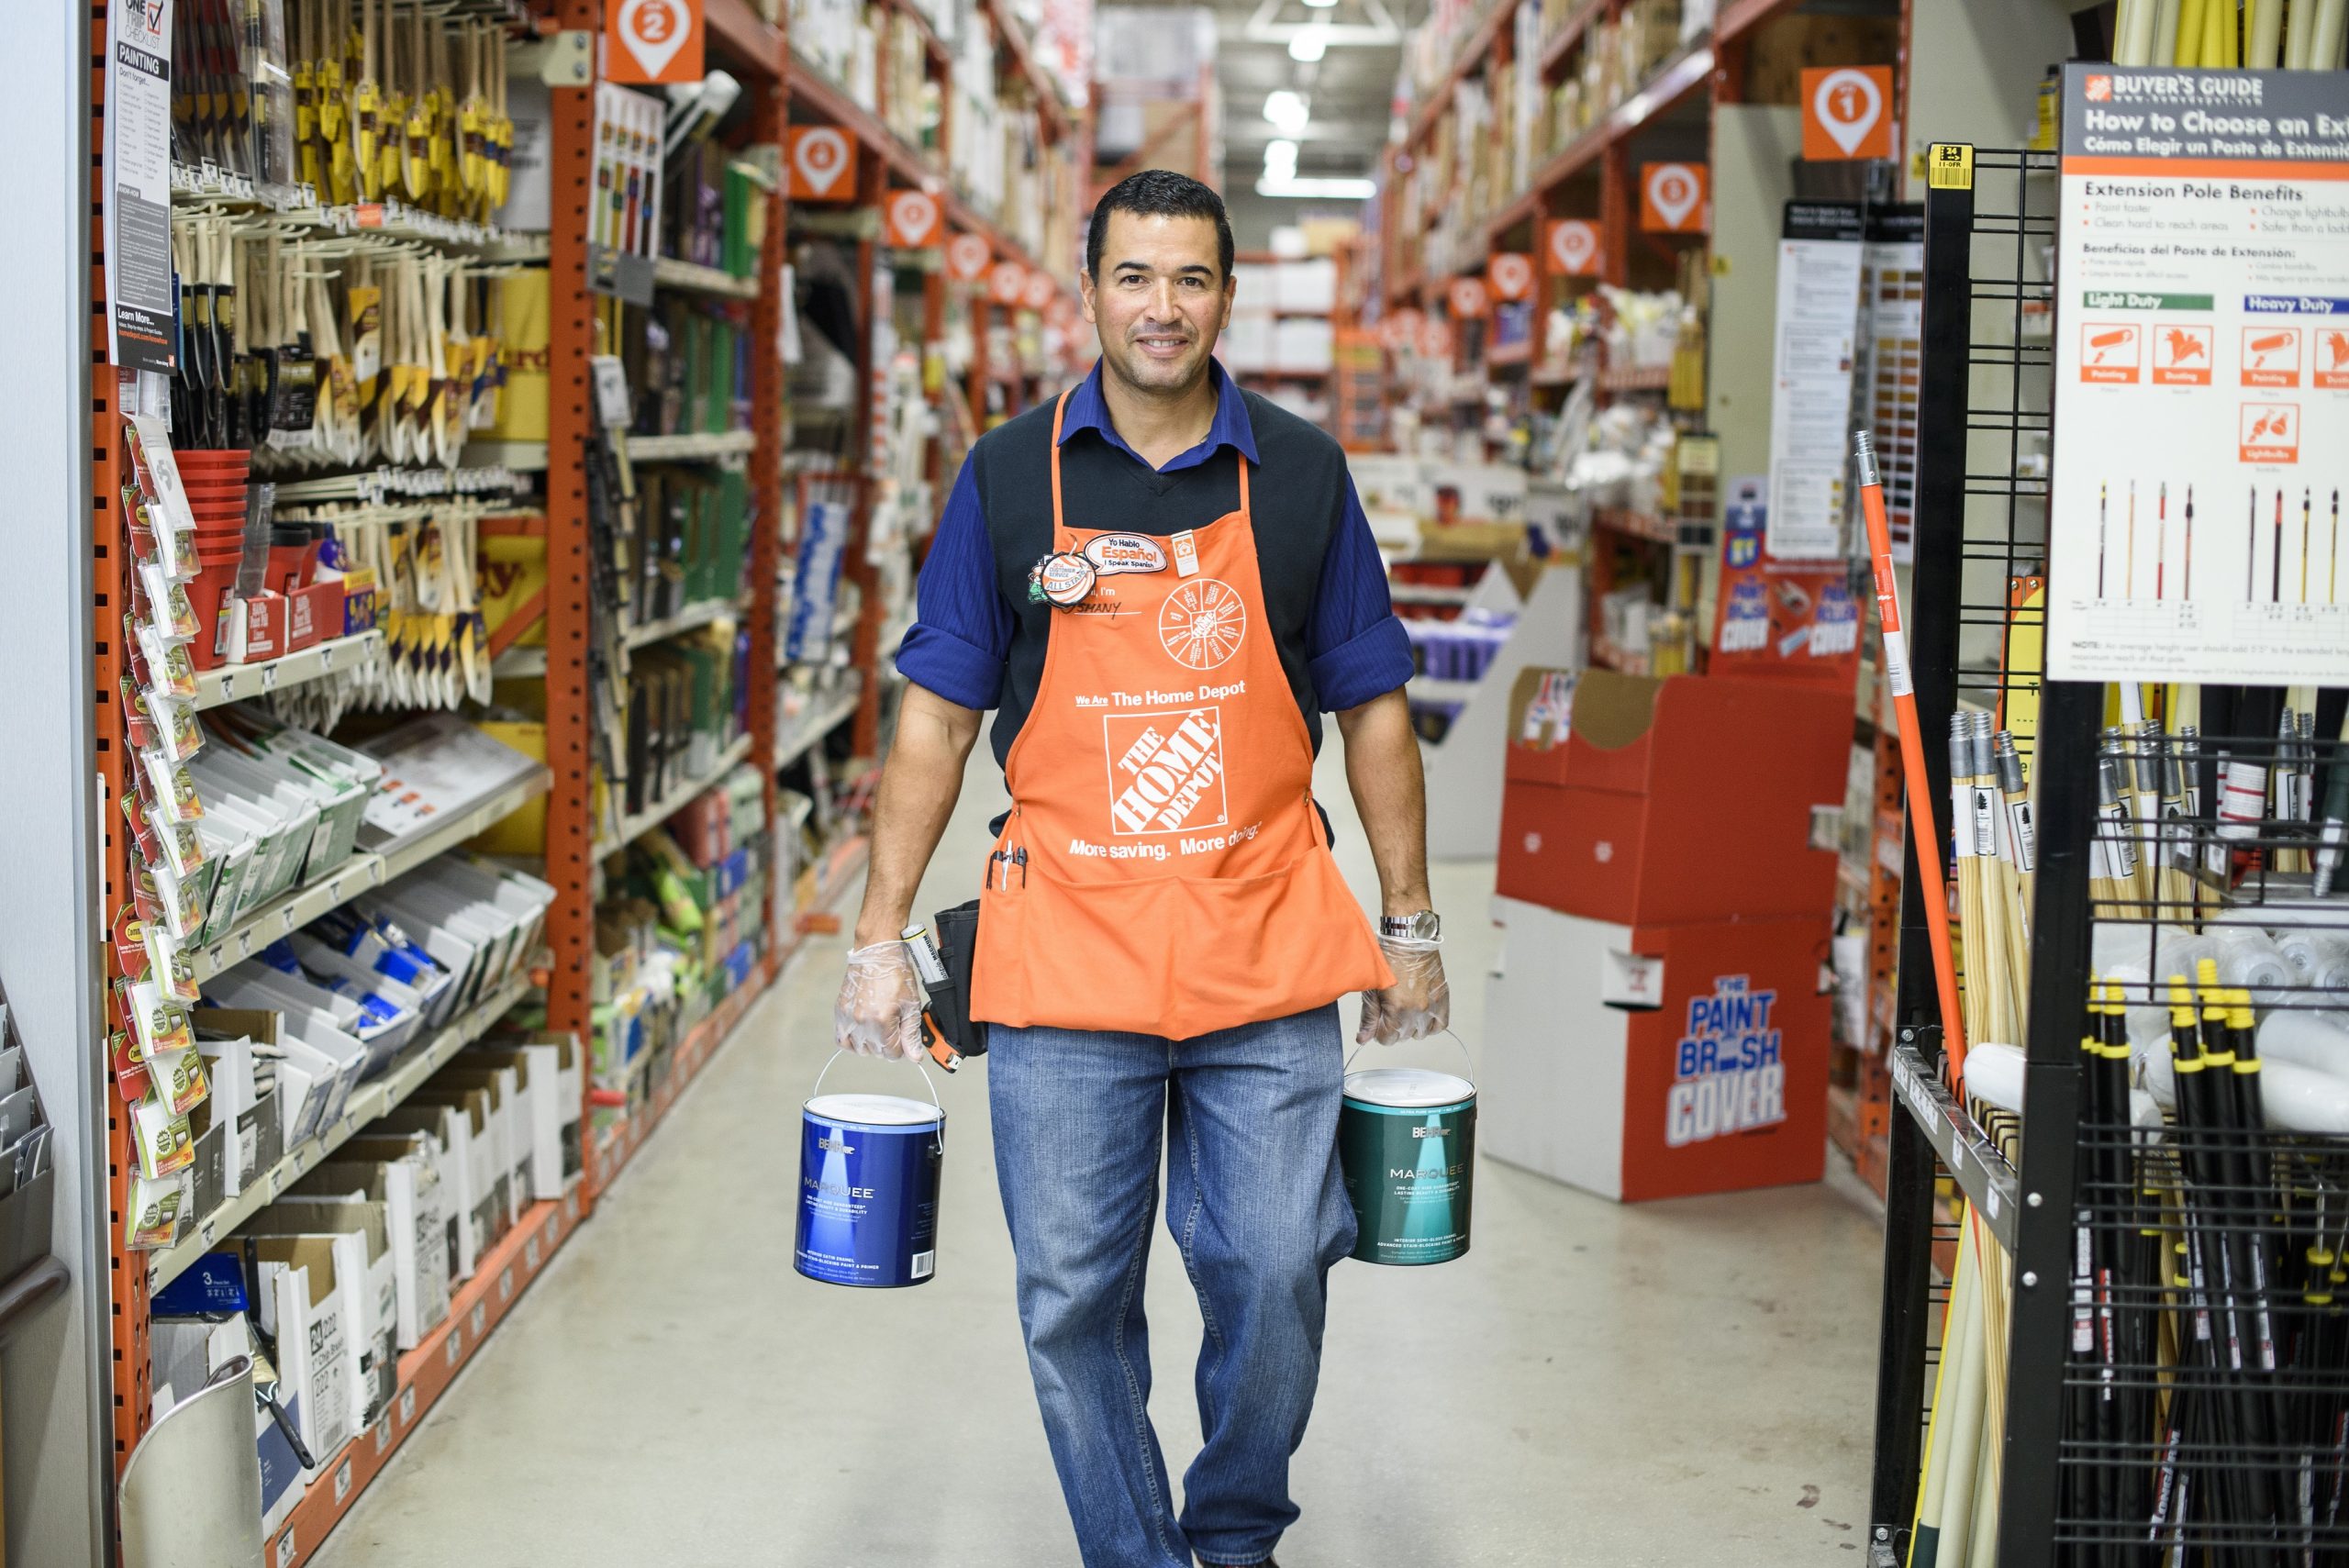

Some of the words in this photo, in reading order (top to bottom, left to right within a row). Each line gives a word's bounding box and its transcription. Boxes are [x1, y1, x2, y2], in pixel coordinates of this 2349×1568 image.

[126, 0, 146, 16] ONE
[126, 9, 145, 28] TRIP
[643, 13, 666, 39] 2
[126, 25, 160, 50] CHECKLIST
[119, 44, 159, 74] PAINTING
[2113, 74, 2195, 95] BUYER'S
[2200, 76, 2263, 97] GUIDE
[1839, 95, 1854, 119] 1
[2086, 109, 2144, 132] How
[2150, 112, 2176, 134] to
[2182, 109, 2271, 137] Choose
[2277, 117, 2310, 138] an
[1946, 147, 1957, 155] 24
[2084, 136, 2132, 152] Cómo
[2136, 137, 2183, 157] Elegir
[2186, 141, 2209, 155] un
[2211, 139, 2256, 156] Poste
[2260, 139, 2282, 157] de
[2085, 182, 2175, 198] Extension
[2183, 183, 2222, 198] Pole
[2262, 206, 2301, 220] Change
[2094, 217, 2123, 228] Clean
[2129, 218, 2153, 228] hard
[2156, 218, 2165, 228] to
[2170, 218, 2196, 229] reach
[2200, 221, 2229, 230] areas
[2261, 221, 2287, 233] Safer
[2292, 222, 2313, 233] than
[2083, 243, 2145, 254] Beneficios
[2151, 245, 2169, 255] del
[2174, 245, 2207, 256] Poste
[2212, 246, 2226, 257] de
[2087, 292, 2125, 309] Light
[2127, 294, 2162, 310] Duty
[2248, 297, 2296, 314] Heavy
[2299, 298, 2333, 314] Duty
[117, 307, 135, 321] Learn
[2090, 370, 2127, 381] Painting
[2165, 372, 2198, 382] Dusting
[2252, 373, 2288, 384] Painting
[1119, 539, 1140, 548] Hablo
[1102, 546, 1157, 562] Español
[1101, 587, 1115, 596] I'm
[1075, 695, 1090, 705] We
[1091, 695, 1108, 705] Are
[1111, 692, 1142, 706] The
[1146, 691, 1195, 705] Home
[1199, 680, 1245, 700] Depot
[1118, 727, 1165, 775] THE
[1113, 710, 1219, 833] HOME
[1157, 751, 1221, 831] DEPOT
[1069, 840, 1107, 856] More
[1109, 841, 1171, 861] saving.
[1180, 837, 1225, 855] More
[922, 934, 938, 961] MAGNUM
[1719, 978, 1745, 992] THE
[1691, 994, 1775, 1035] PAINT
[1666, 1063, 1786, 1148] COVER
[1412, 1126, 1442, 1138] BEHR
[818, 1137, 842, 1152] BEHR
[183, 1151, 193, 1162] 3M
[1390, 1163, 1464, 1179] MARQUEE
[804, 1175, 874, 1198] MARQUEE
[160, 1229, 171, 1240] 3M
[203, 1272, 213, 1285] 3
[323, 1312, 337, 1340] 222
[315, 1370, 329, 1397] 222
